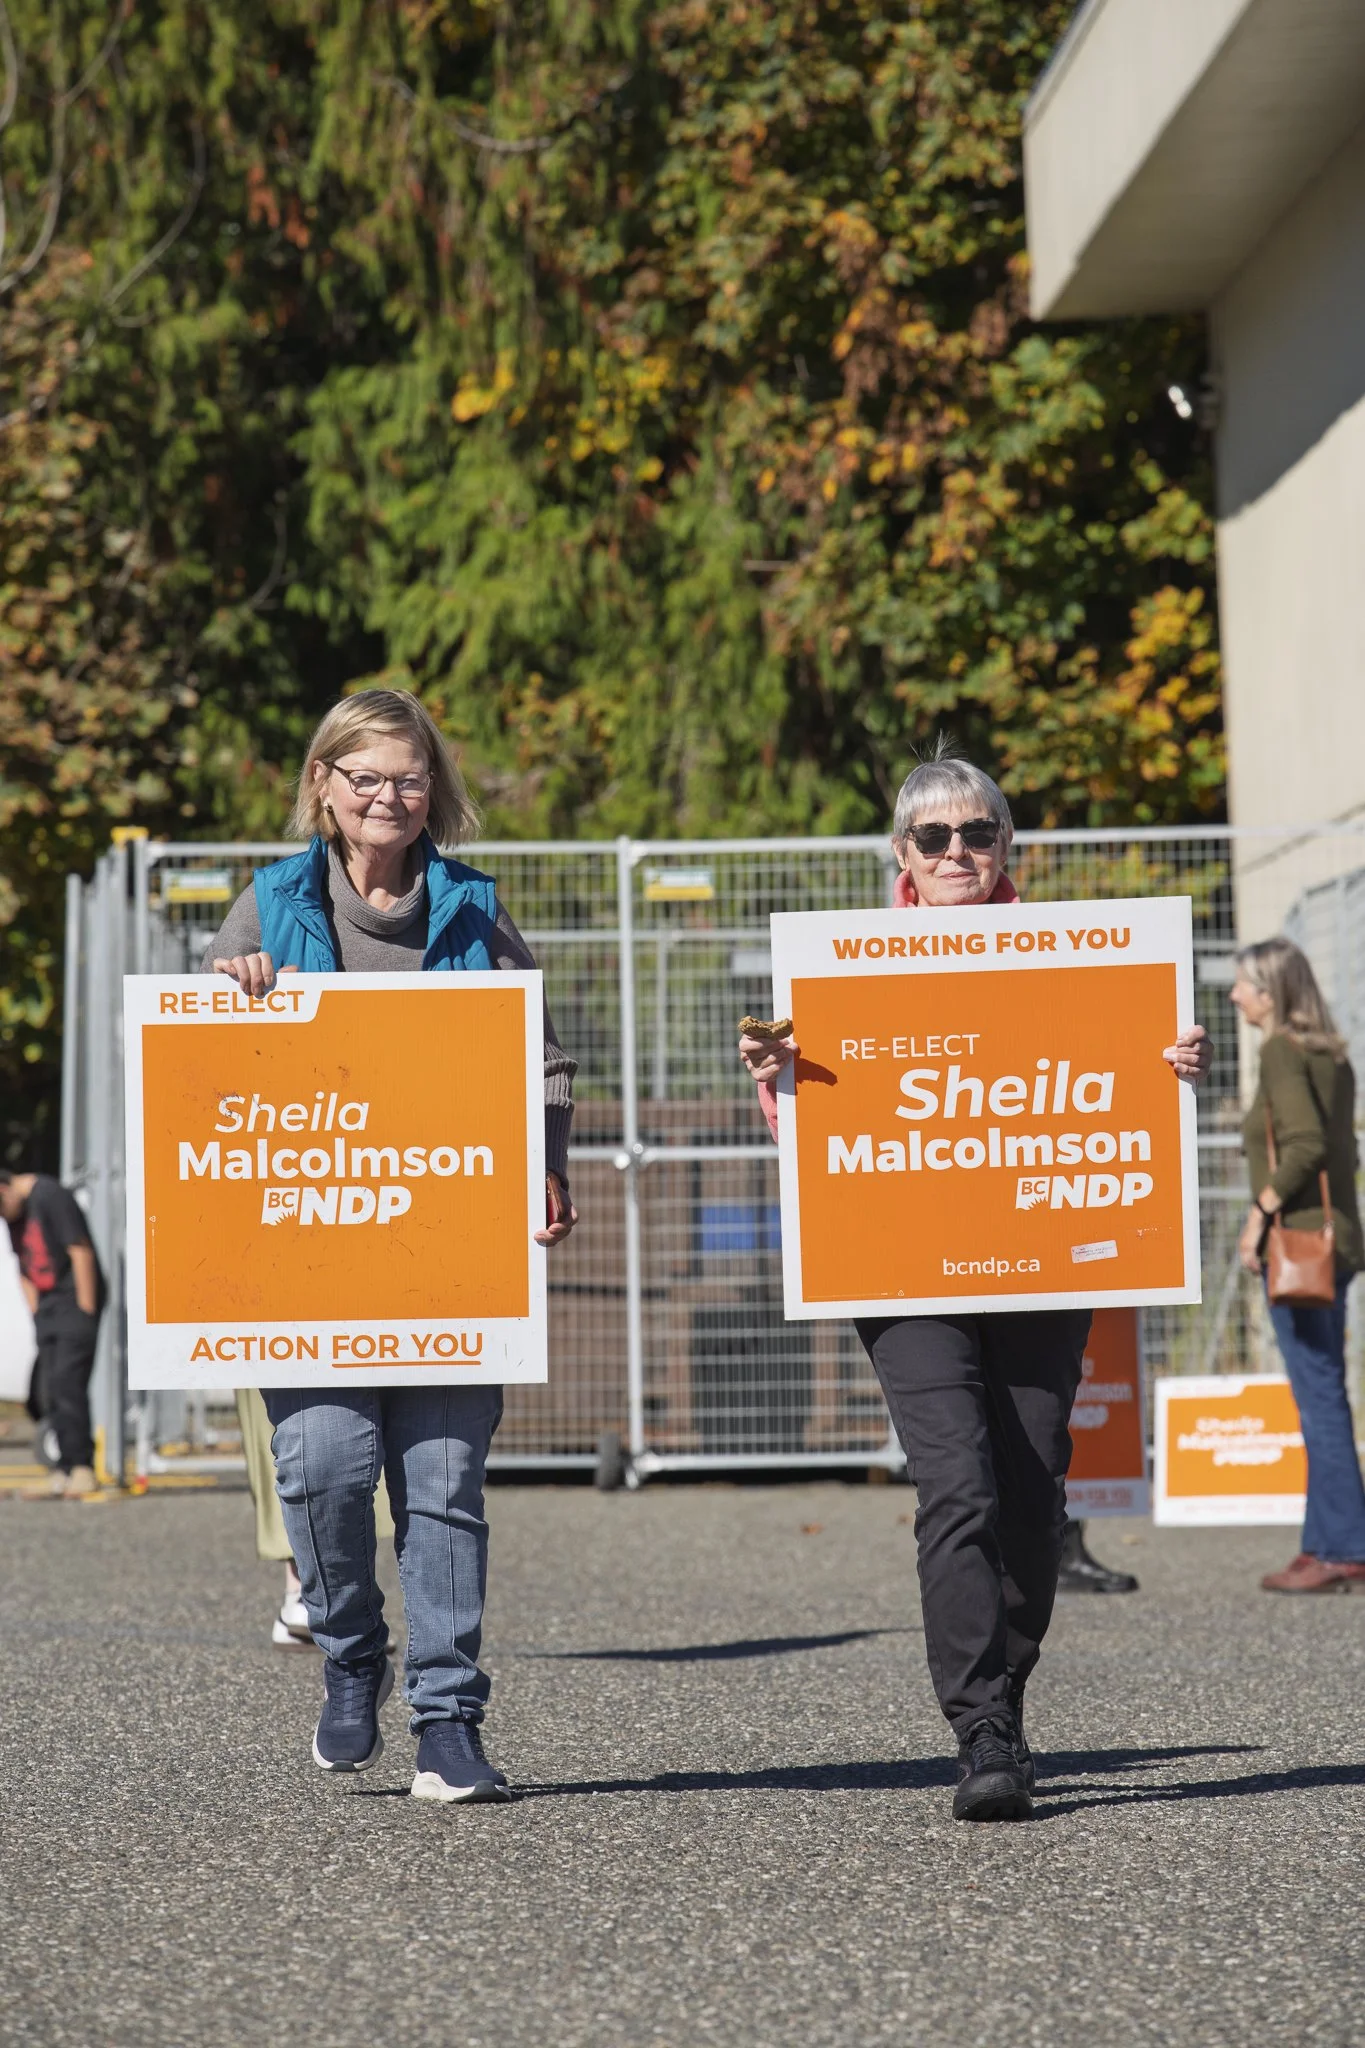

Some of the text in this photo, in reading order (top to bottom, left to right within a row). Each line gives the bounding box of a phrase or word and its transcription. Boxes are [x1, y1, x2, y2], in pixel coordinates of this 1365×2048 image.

[833, 927, 1131, 960] WORKING FOR YOU
[159, 990, 305, 1014] RE-ELECT
[841, 1033, 981, 1060] RE-ELECT
[894, 1057, 1115, 1121] Sheila
[214, 1092, 370, 1133] Sheila
[178, 1137, 494, 1181] Malcolmson
[827, 1127, 1152, 1175] Malcolmson
[942, 1256, 1041, 1277] bcndp.ca
[190, 1332, 483, 1361] ACTION FOR YOU
